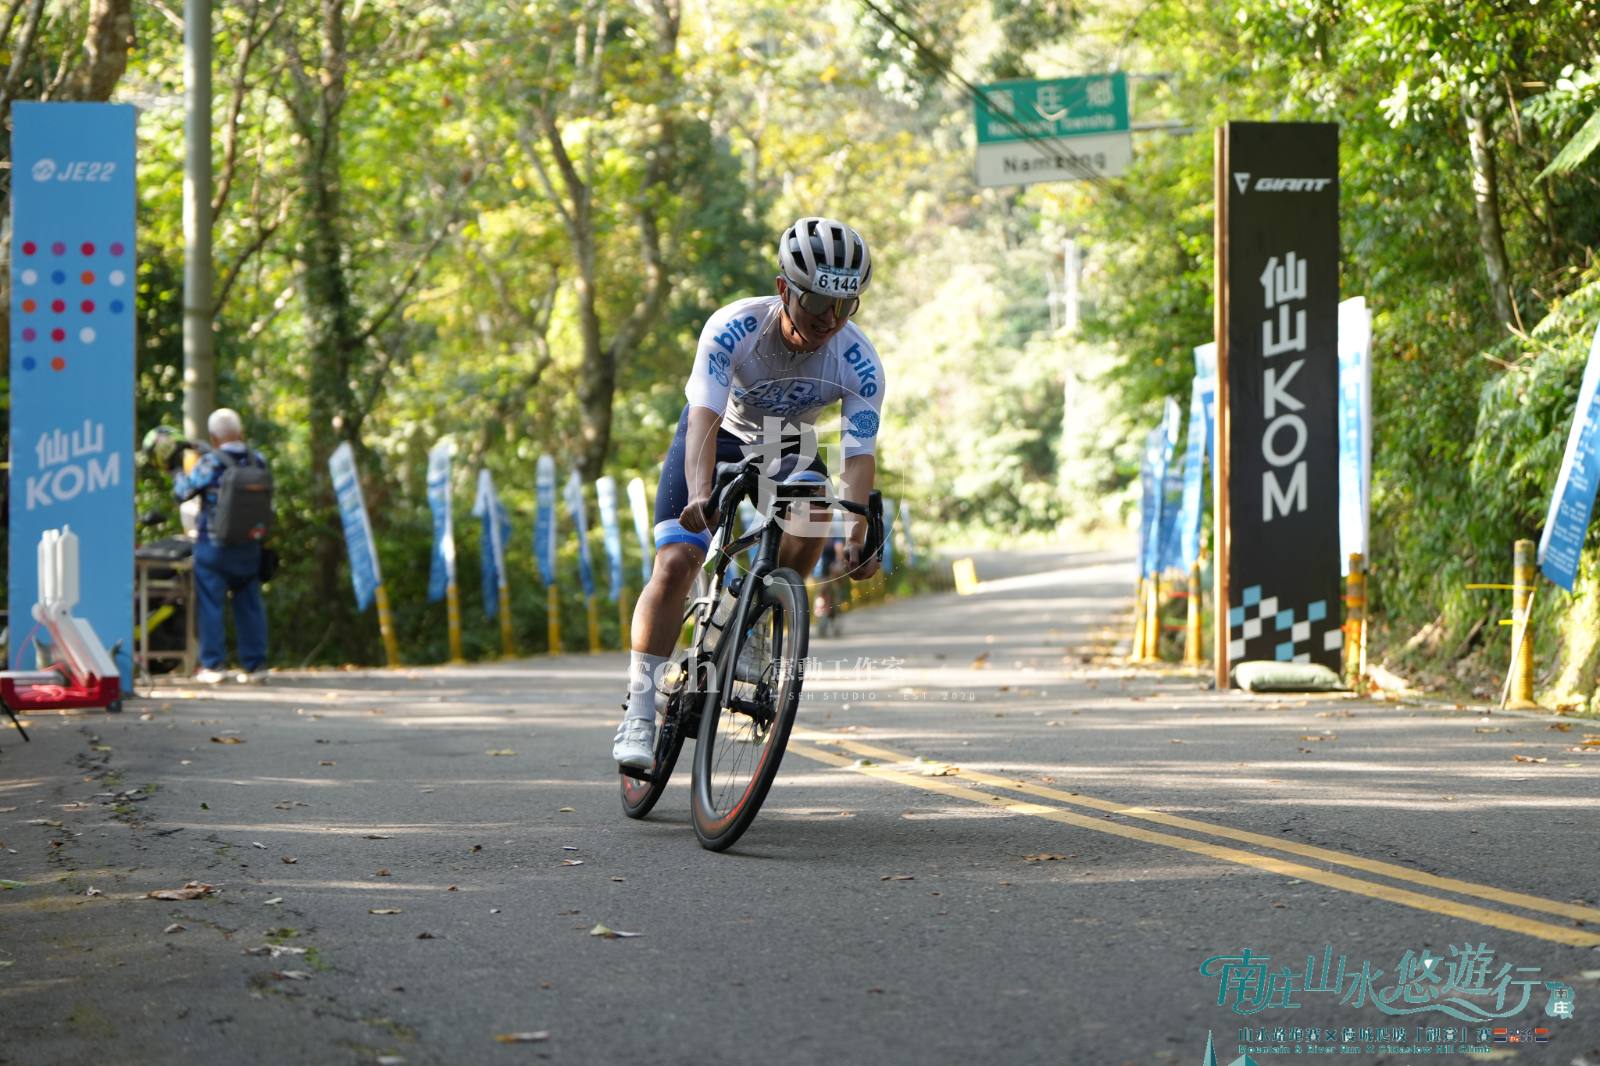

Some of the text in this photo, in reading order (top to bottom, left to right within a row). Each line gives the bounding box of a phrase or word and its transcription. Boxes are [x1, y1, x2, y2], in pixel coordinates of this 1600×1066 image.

[57, 161, 116, 181] JE22
[1254, 178, 1332, 192] GIANT
[818, 273, 858, 292] 6144
[713, 315, 758, 354] bite
[843, 342, 878, 398] bike
[1259, 251, 1308, 522] 仙山 KOM
[35, 419, 104, 470] 仙山
[26, 452, 119, 510] KOM
